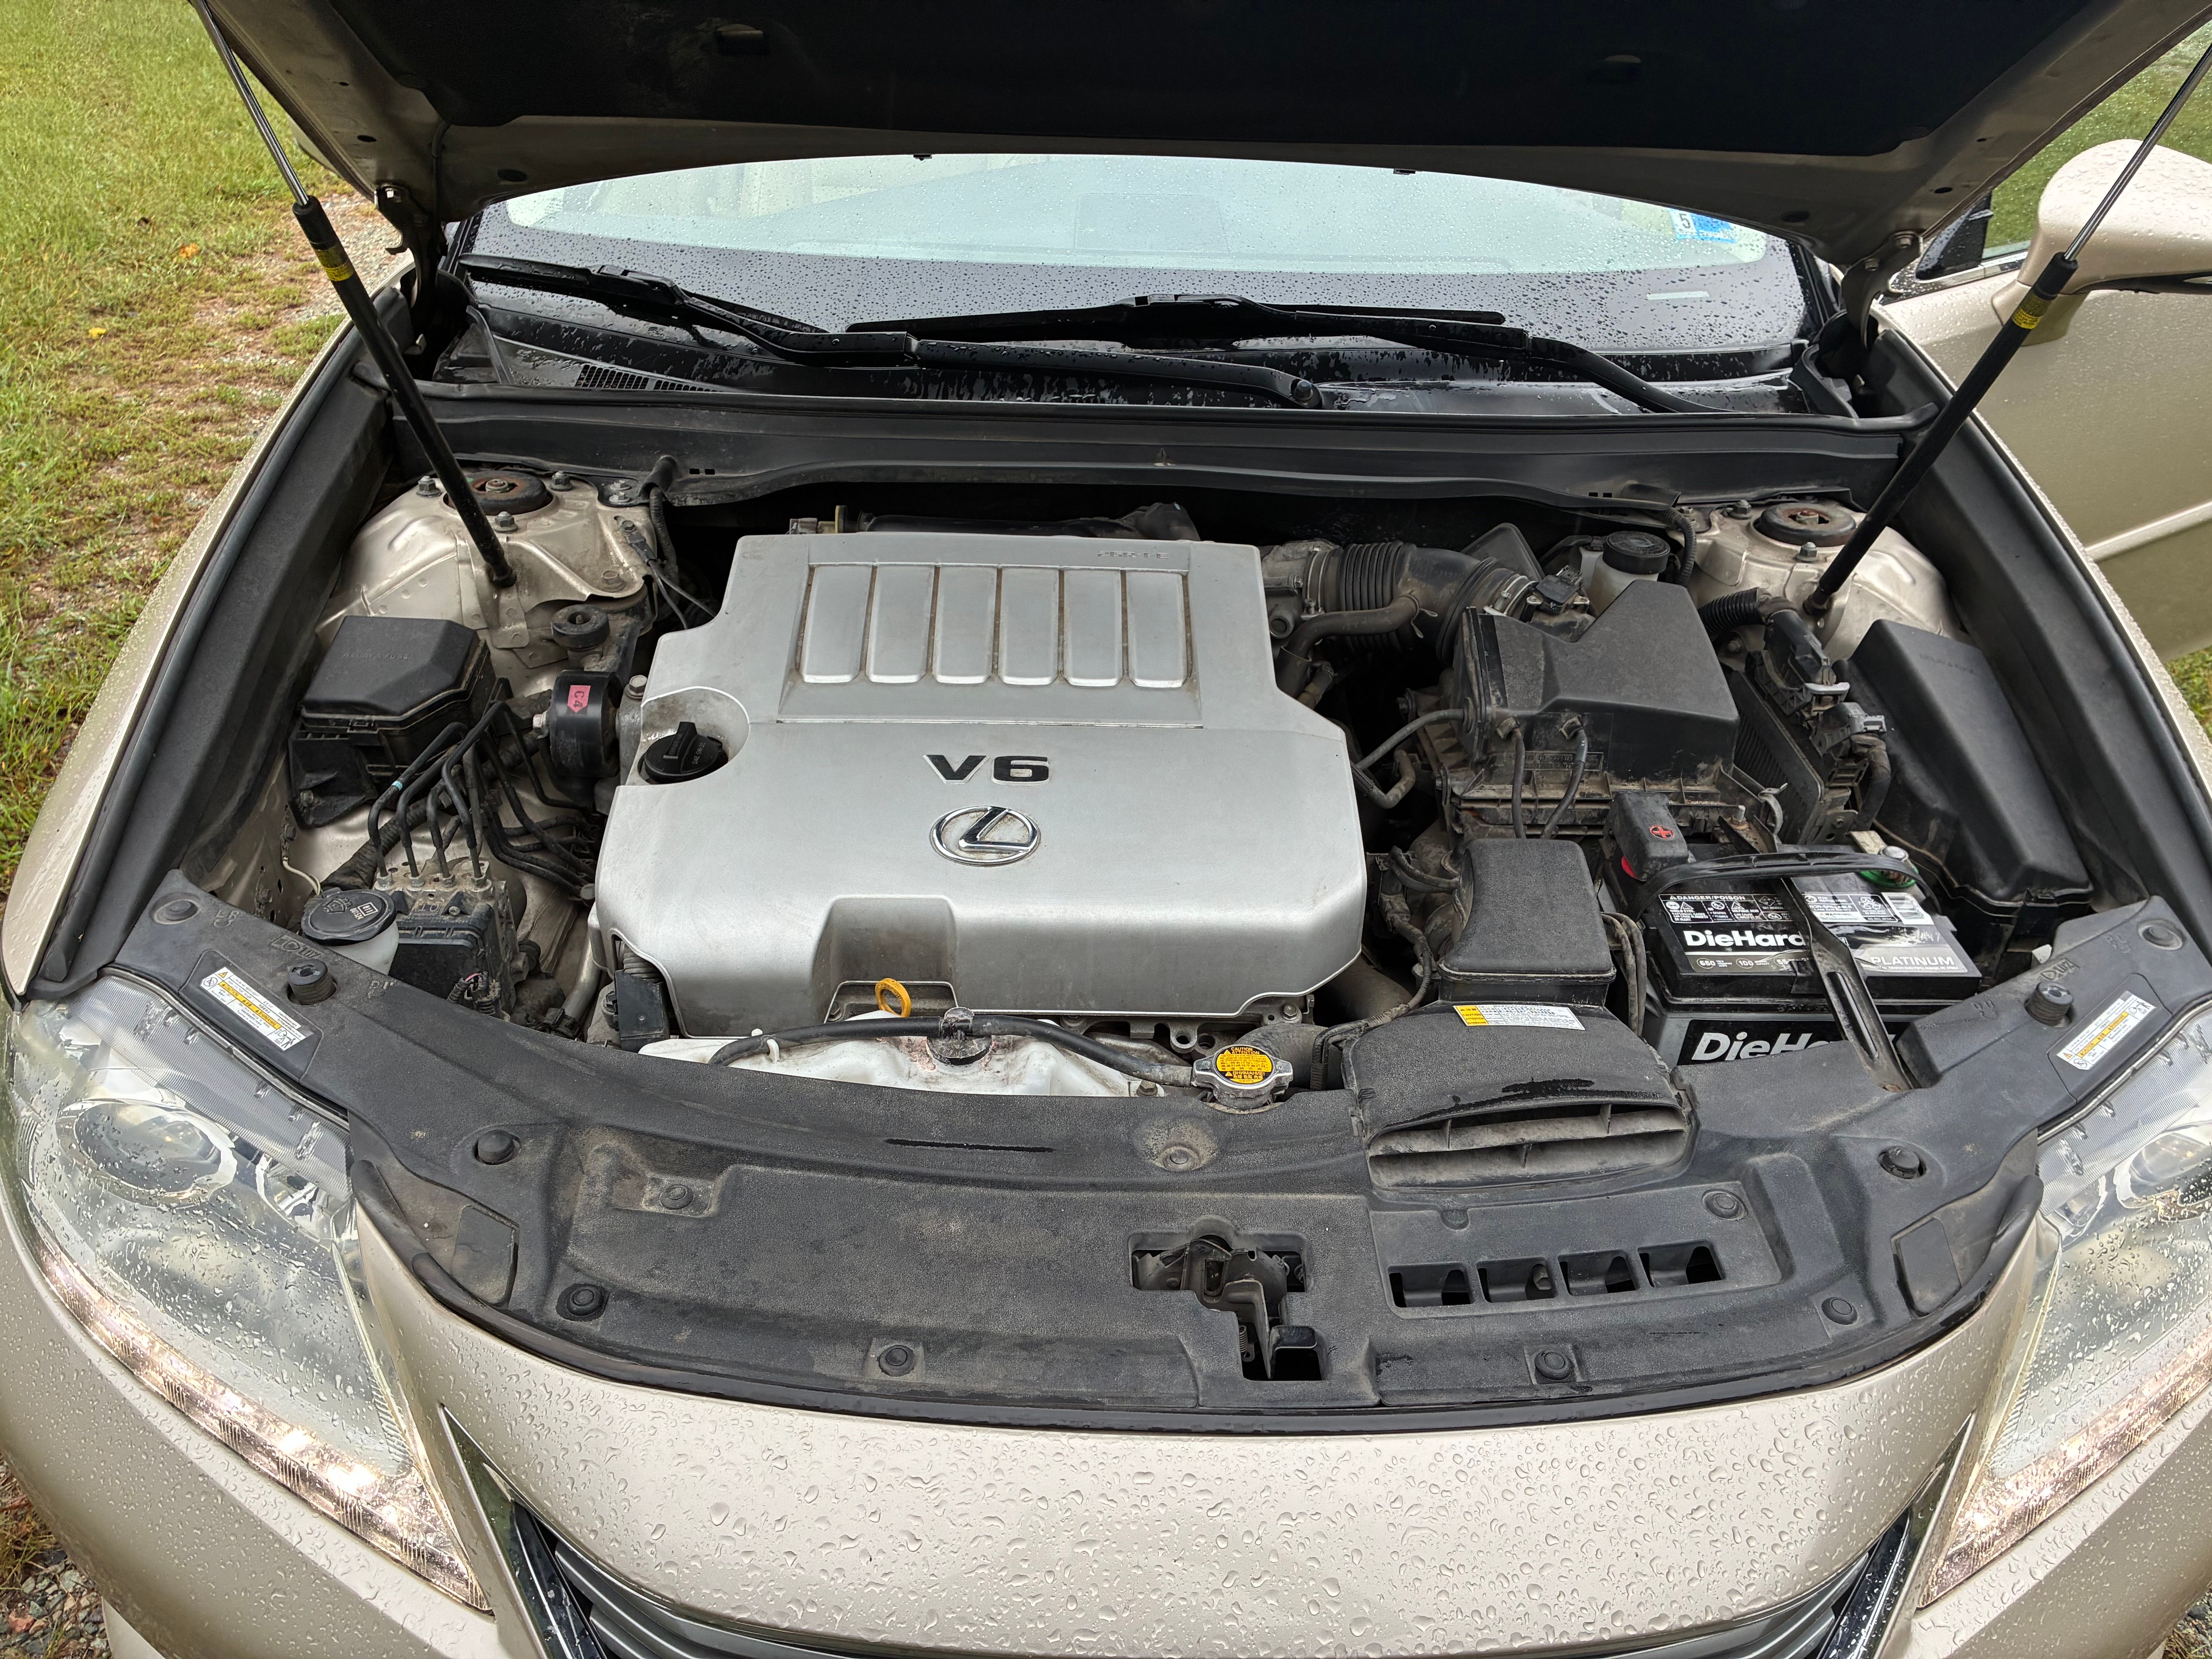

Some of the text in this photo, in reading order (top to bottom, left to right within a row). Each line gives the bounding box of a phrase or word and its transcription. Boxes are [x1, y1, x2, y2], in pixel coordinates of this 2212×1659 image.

[1679, 213, 1691, 228] 5
[573, 690, 584, 708] C4
[923, 754, 1049, 785] V6
[1683, 930, 1806, 946] DieHard
[1870, 957, 1954, 965] PLATINUM
[1692, 1032, 1830, 1061] DieH
